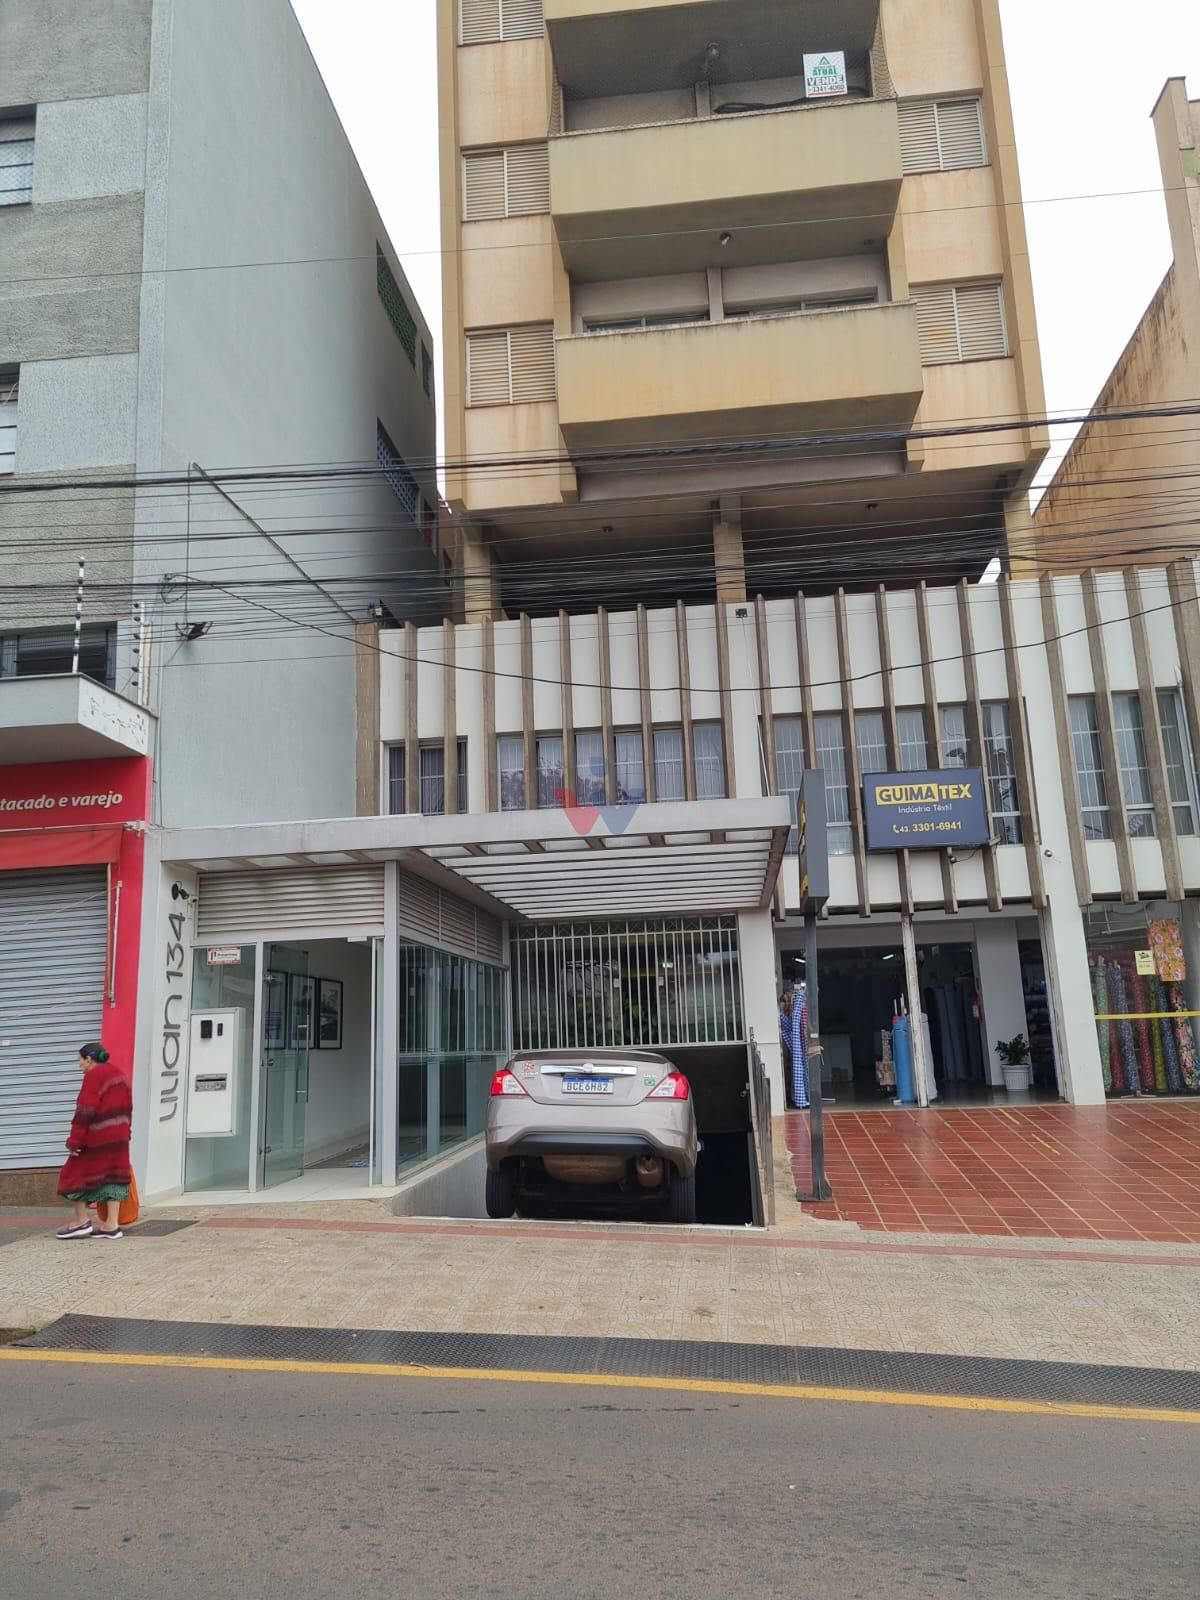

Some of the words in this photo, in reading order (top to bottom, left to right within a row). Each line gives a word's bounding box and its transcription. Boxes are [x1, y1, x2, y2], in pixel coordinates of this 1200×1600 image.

[812, 66, 838, 76] ATUAL
[807, 75, 844, 86] VENDE
[58, 796, 67, 807] e
[71, 790, 123, 808] varejo
[878, 783, 973, 803] GUIMATEX
[912, 821, 962, 832] 3301-6941
[166, 912, 186, 984] 134
